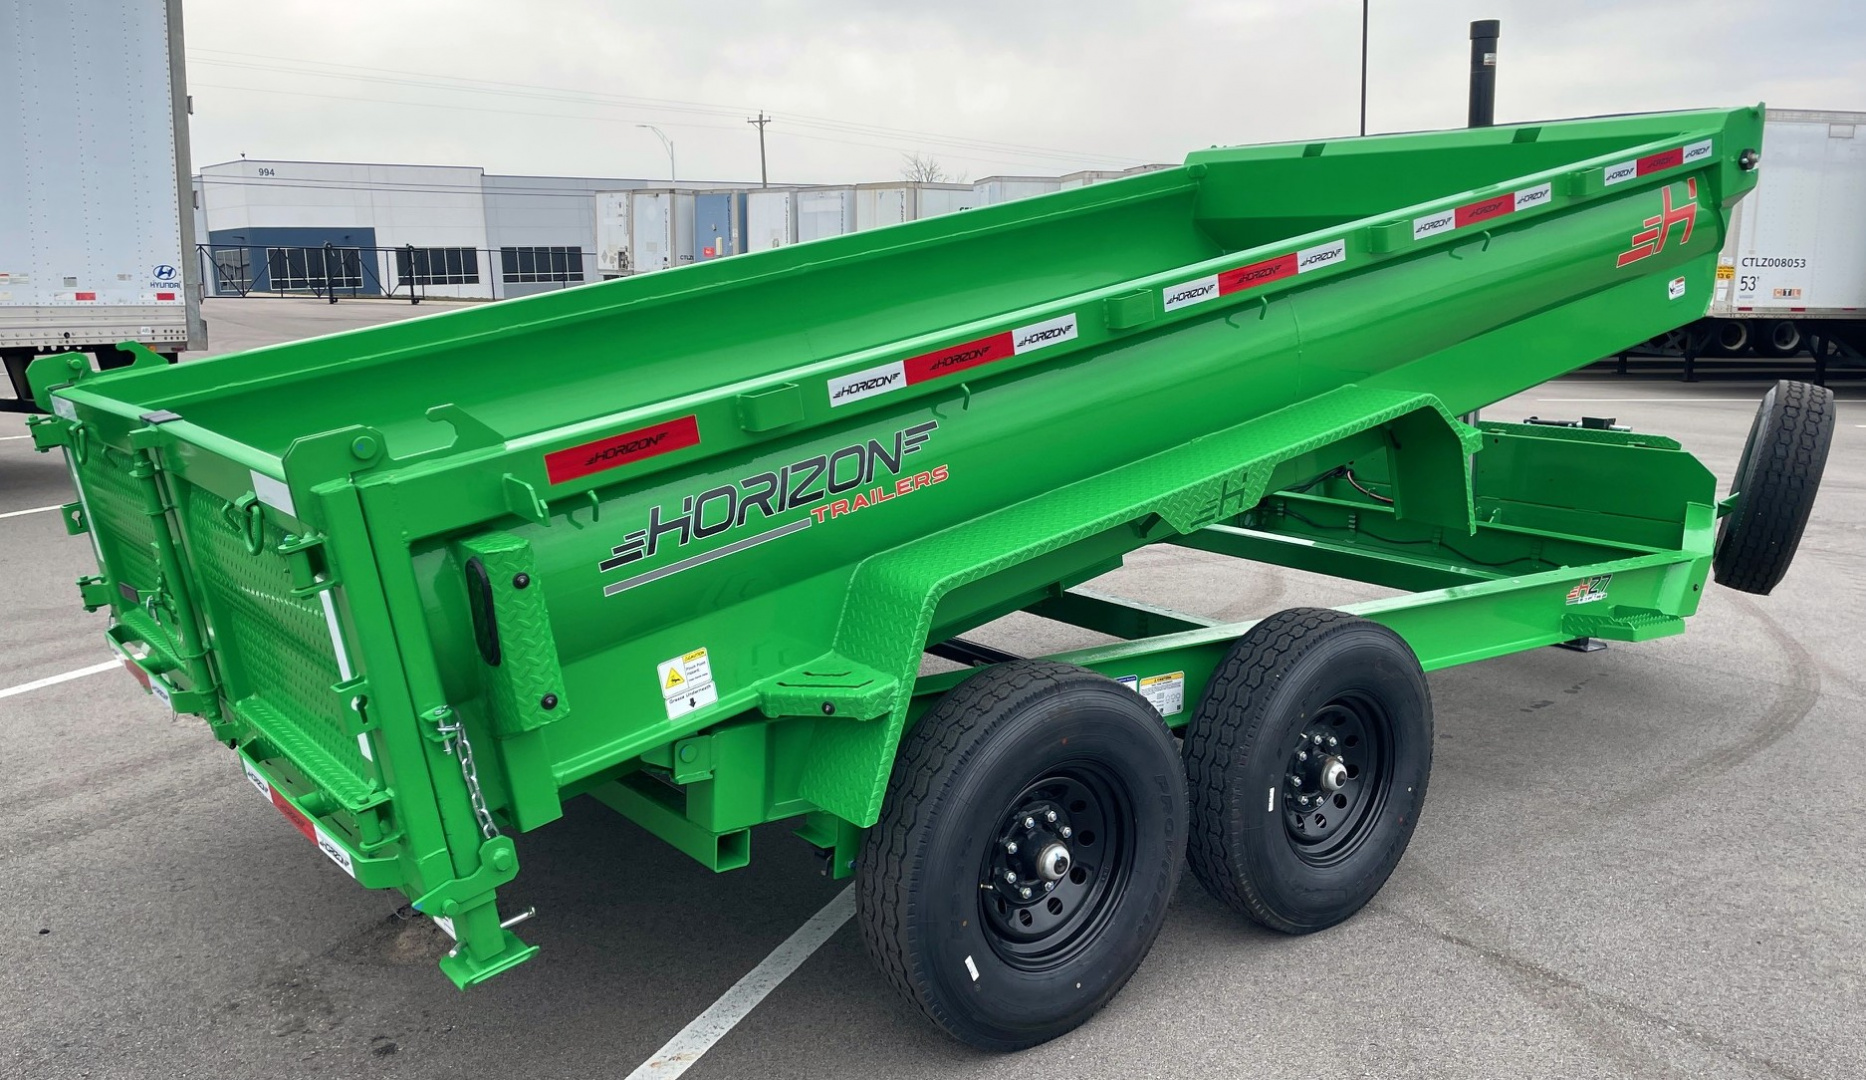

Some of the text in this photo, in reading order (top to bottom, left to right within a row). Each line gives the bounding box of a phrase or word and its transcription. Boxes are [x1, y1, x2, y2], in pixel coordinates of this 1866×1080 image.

[258, 168, 275, 177] 994
[1420, 218, 1449, 232] HORIZON
[1305, 250, 1338, 266] HORIZON
[1741, 258, 1807, 268] CTLZ008053
[1242, 267, 1276, 283] HORIZON
[1740, 276, 1760, 291] 53'
[1172, 285, 1210, 303] HORIZON
[1023, 327, 1068, 346] HORIZON
[936, 348, 986, 371] HORIZON
[841, 374, 894, 397] HORIZON
[593, 434, 661, 464] HORIZON
[646, 430, 903, 557] HORIZON
[811, 465, 950, 523] TRAILERS
[685, 684, 712, 698] Underneath
